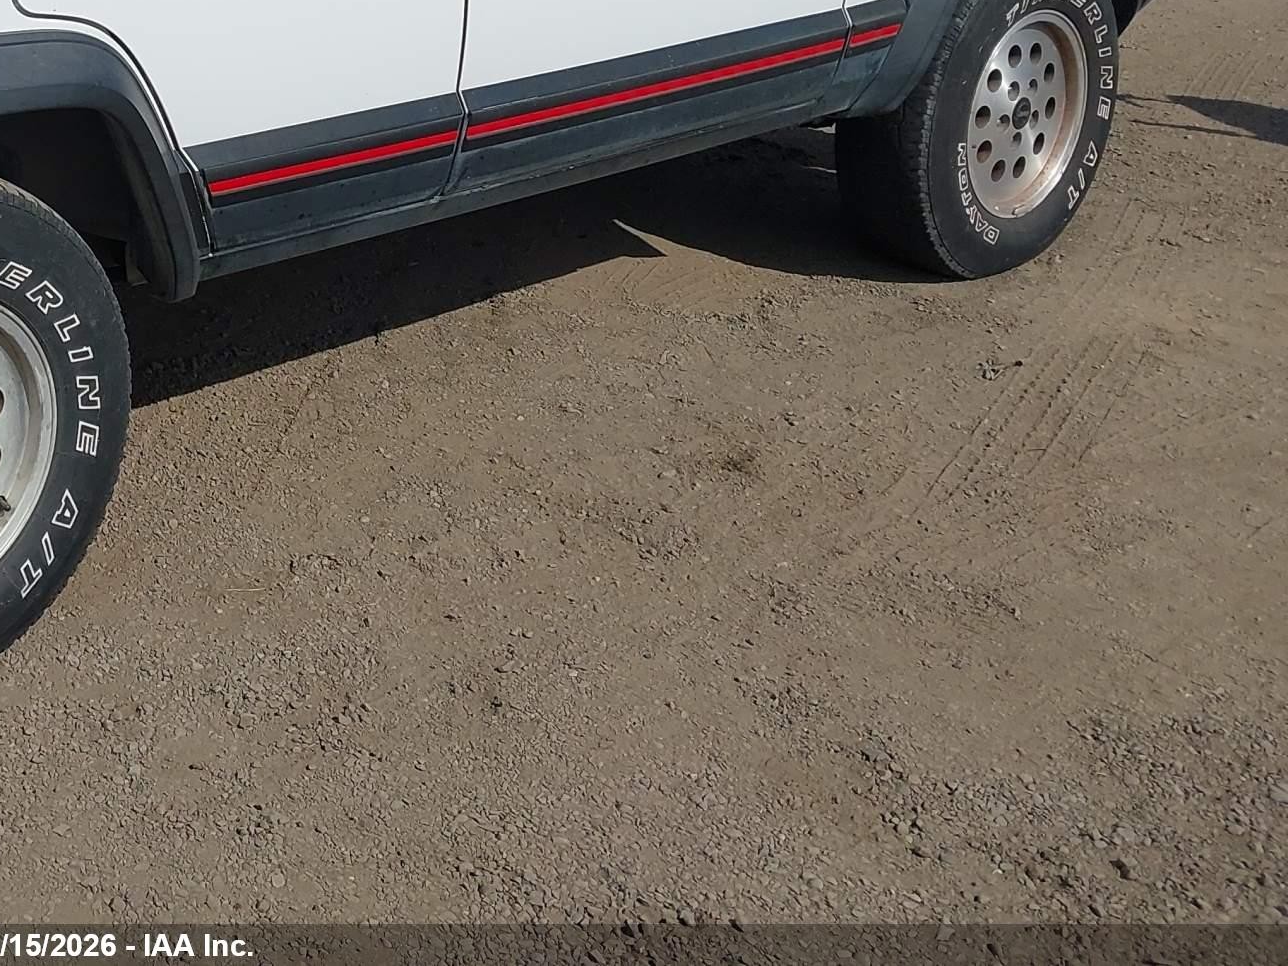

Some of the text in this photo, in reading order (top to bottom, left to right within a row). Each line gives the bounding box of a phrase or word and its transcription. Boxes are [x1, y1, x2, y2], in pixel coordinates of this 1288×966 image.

[957, 141, 1001, 246] DAYTON
[1066, 139, 1099, 212] A/T
[19, 488, 80, 599] A/T
